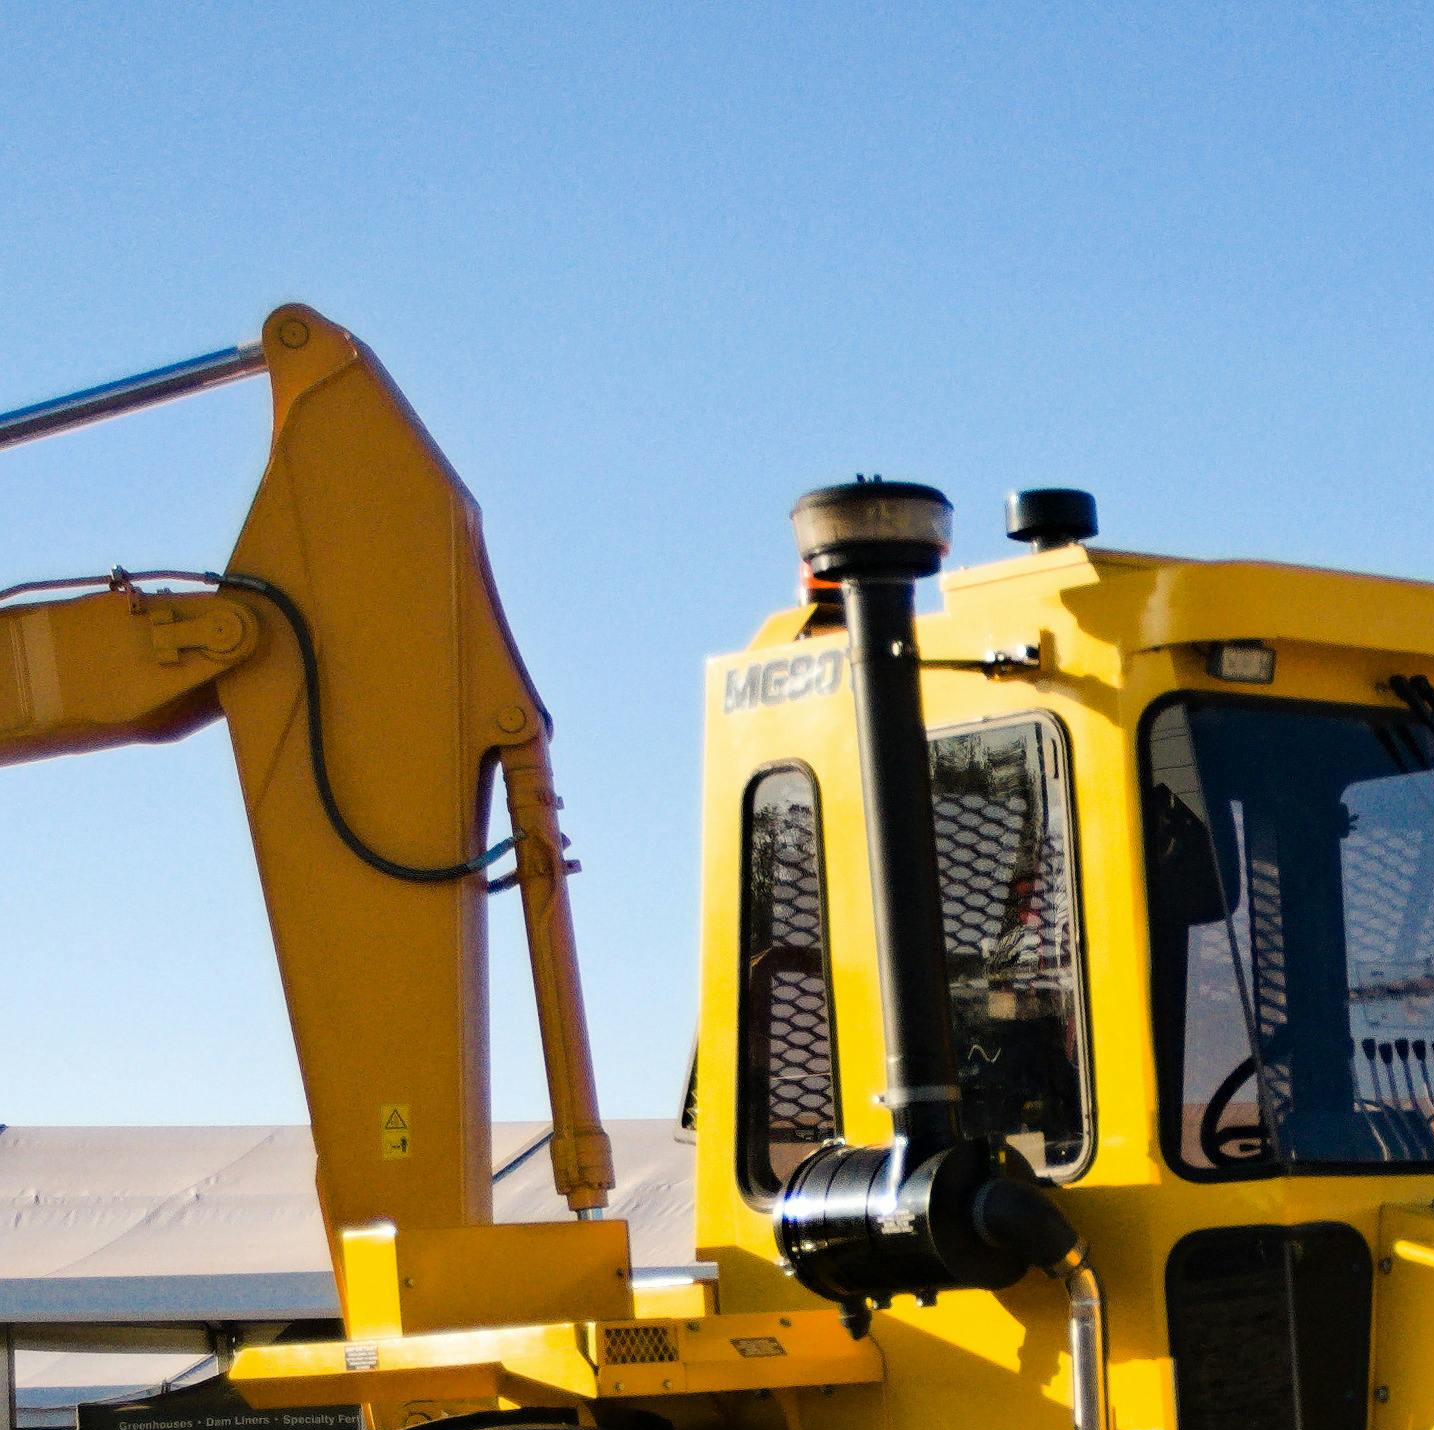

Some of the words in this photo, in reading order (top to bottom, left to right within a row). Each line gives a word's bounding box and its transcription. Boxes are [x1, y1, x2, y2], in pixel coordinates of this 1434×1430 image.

[119, 1420, 193, 1430] Greenhouses
[206, 1416, 232, 1427] Dam
[235, 1416, 270, 1426] Liners
[282, 1414, 334, 1426] Specialty
